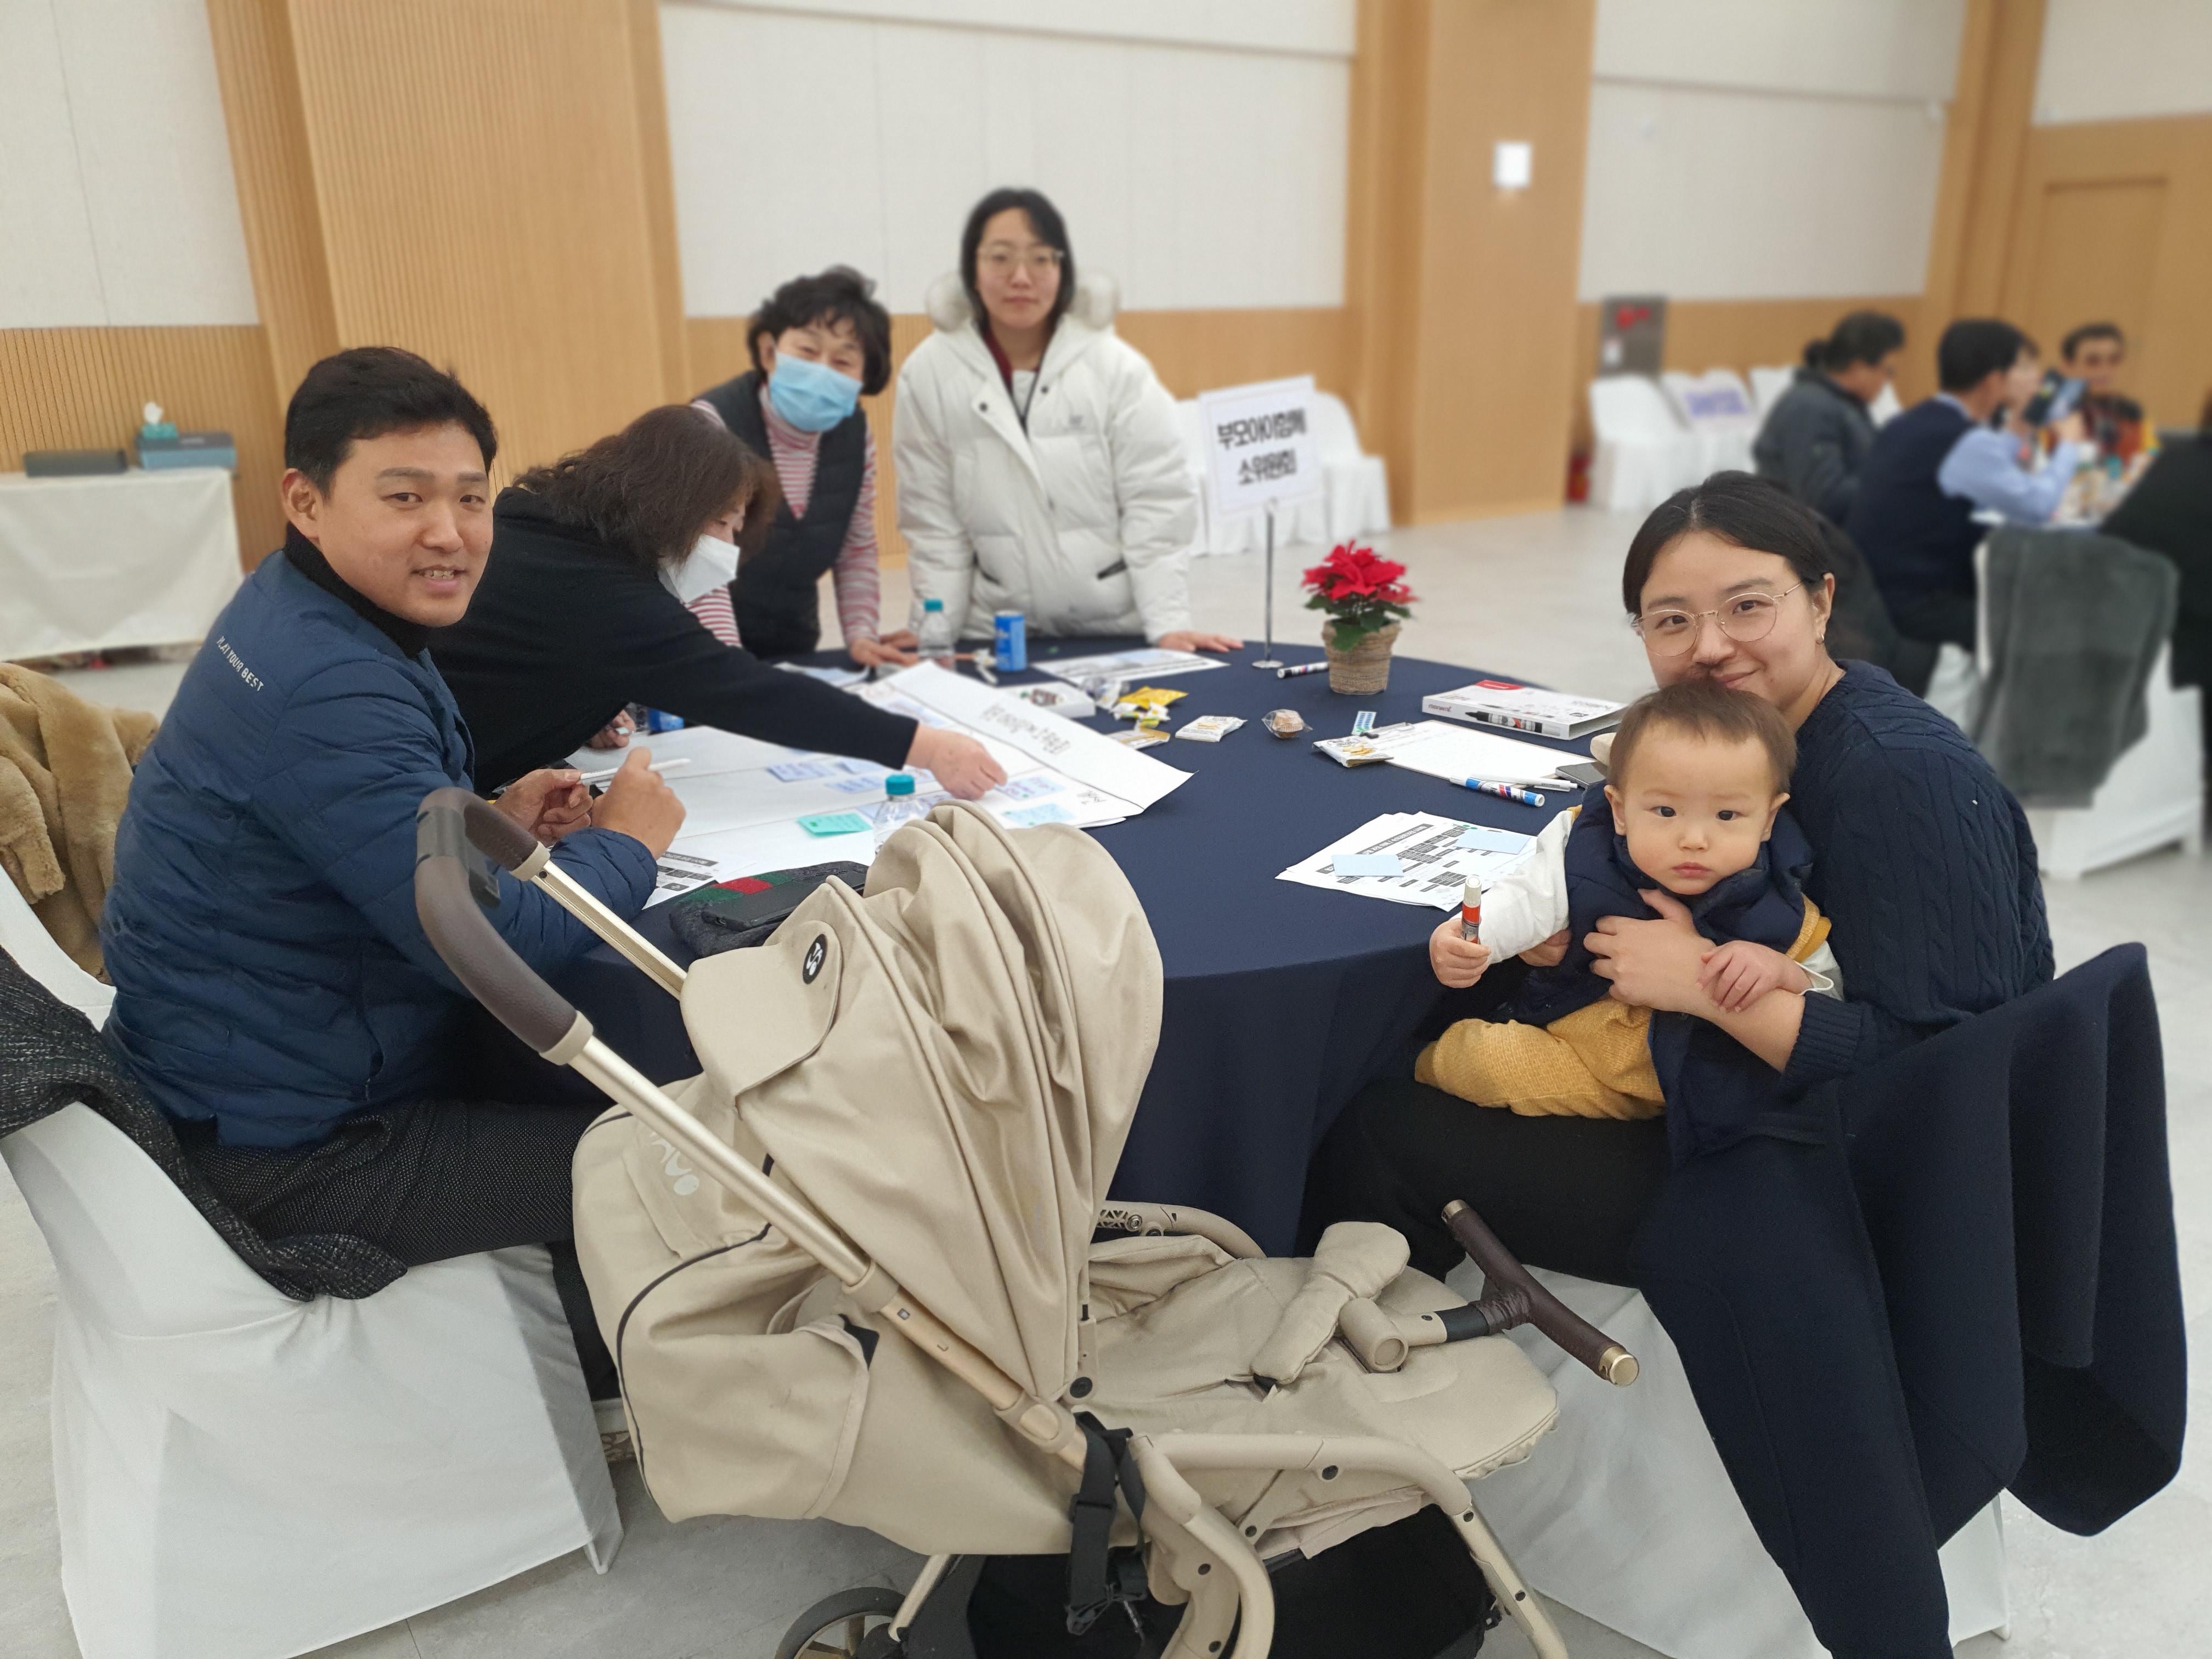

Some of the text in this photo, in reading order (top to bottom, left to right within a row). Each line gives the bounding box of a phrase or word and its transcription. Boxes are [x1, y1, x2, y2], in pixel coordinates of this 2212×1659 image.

[227, 650, 244, 672] YOUR
[241, 667, 264, 692] BEST
[1428, 704, 1452, 713] monami
